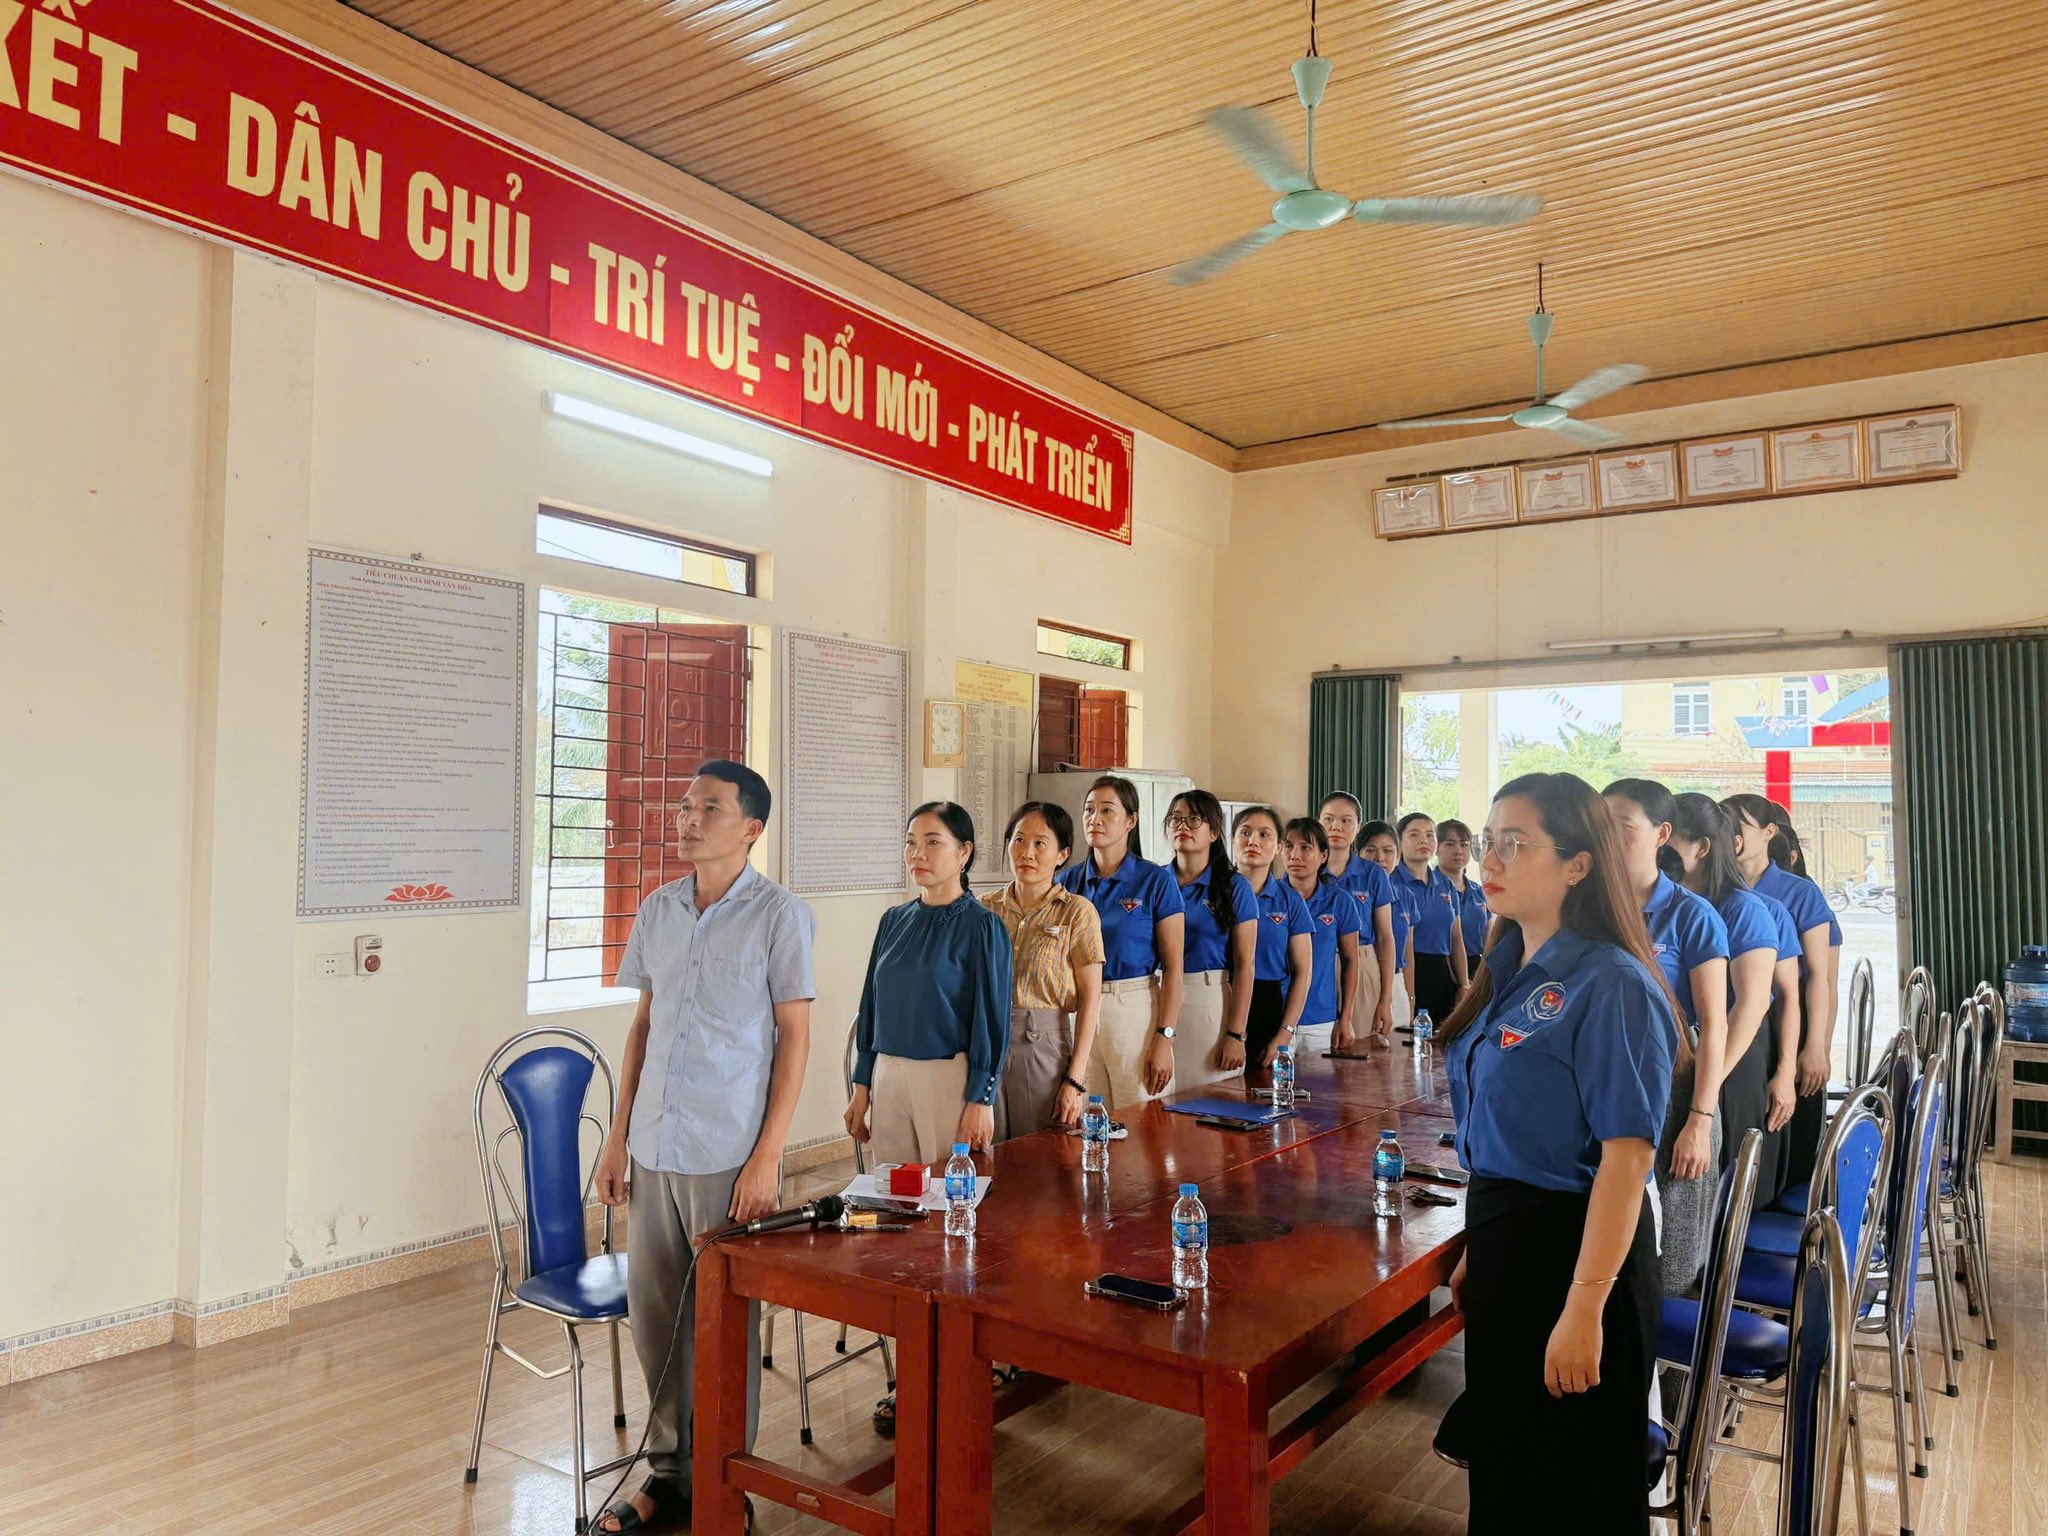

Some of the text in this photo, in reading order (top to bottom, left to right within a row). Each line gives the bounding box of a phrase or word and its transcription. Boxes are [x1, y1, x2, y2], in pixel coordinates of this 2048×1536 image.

[227, 92, 383, 241] DÂN
[407, 172, 531, 292] CHỦ
[588, 241, 667, 347] TRÍ
[681, 292, 761, 397] TUỆ
[802, 324, 864, 421] ĐỔI
[876, 362, 938, 448] MỚI
[968, 403, 1039, 485] PHÁT
[1045, 434, 1112, 512] TRIỂN
